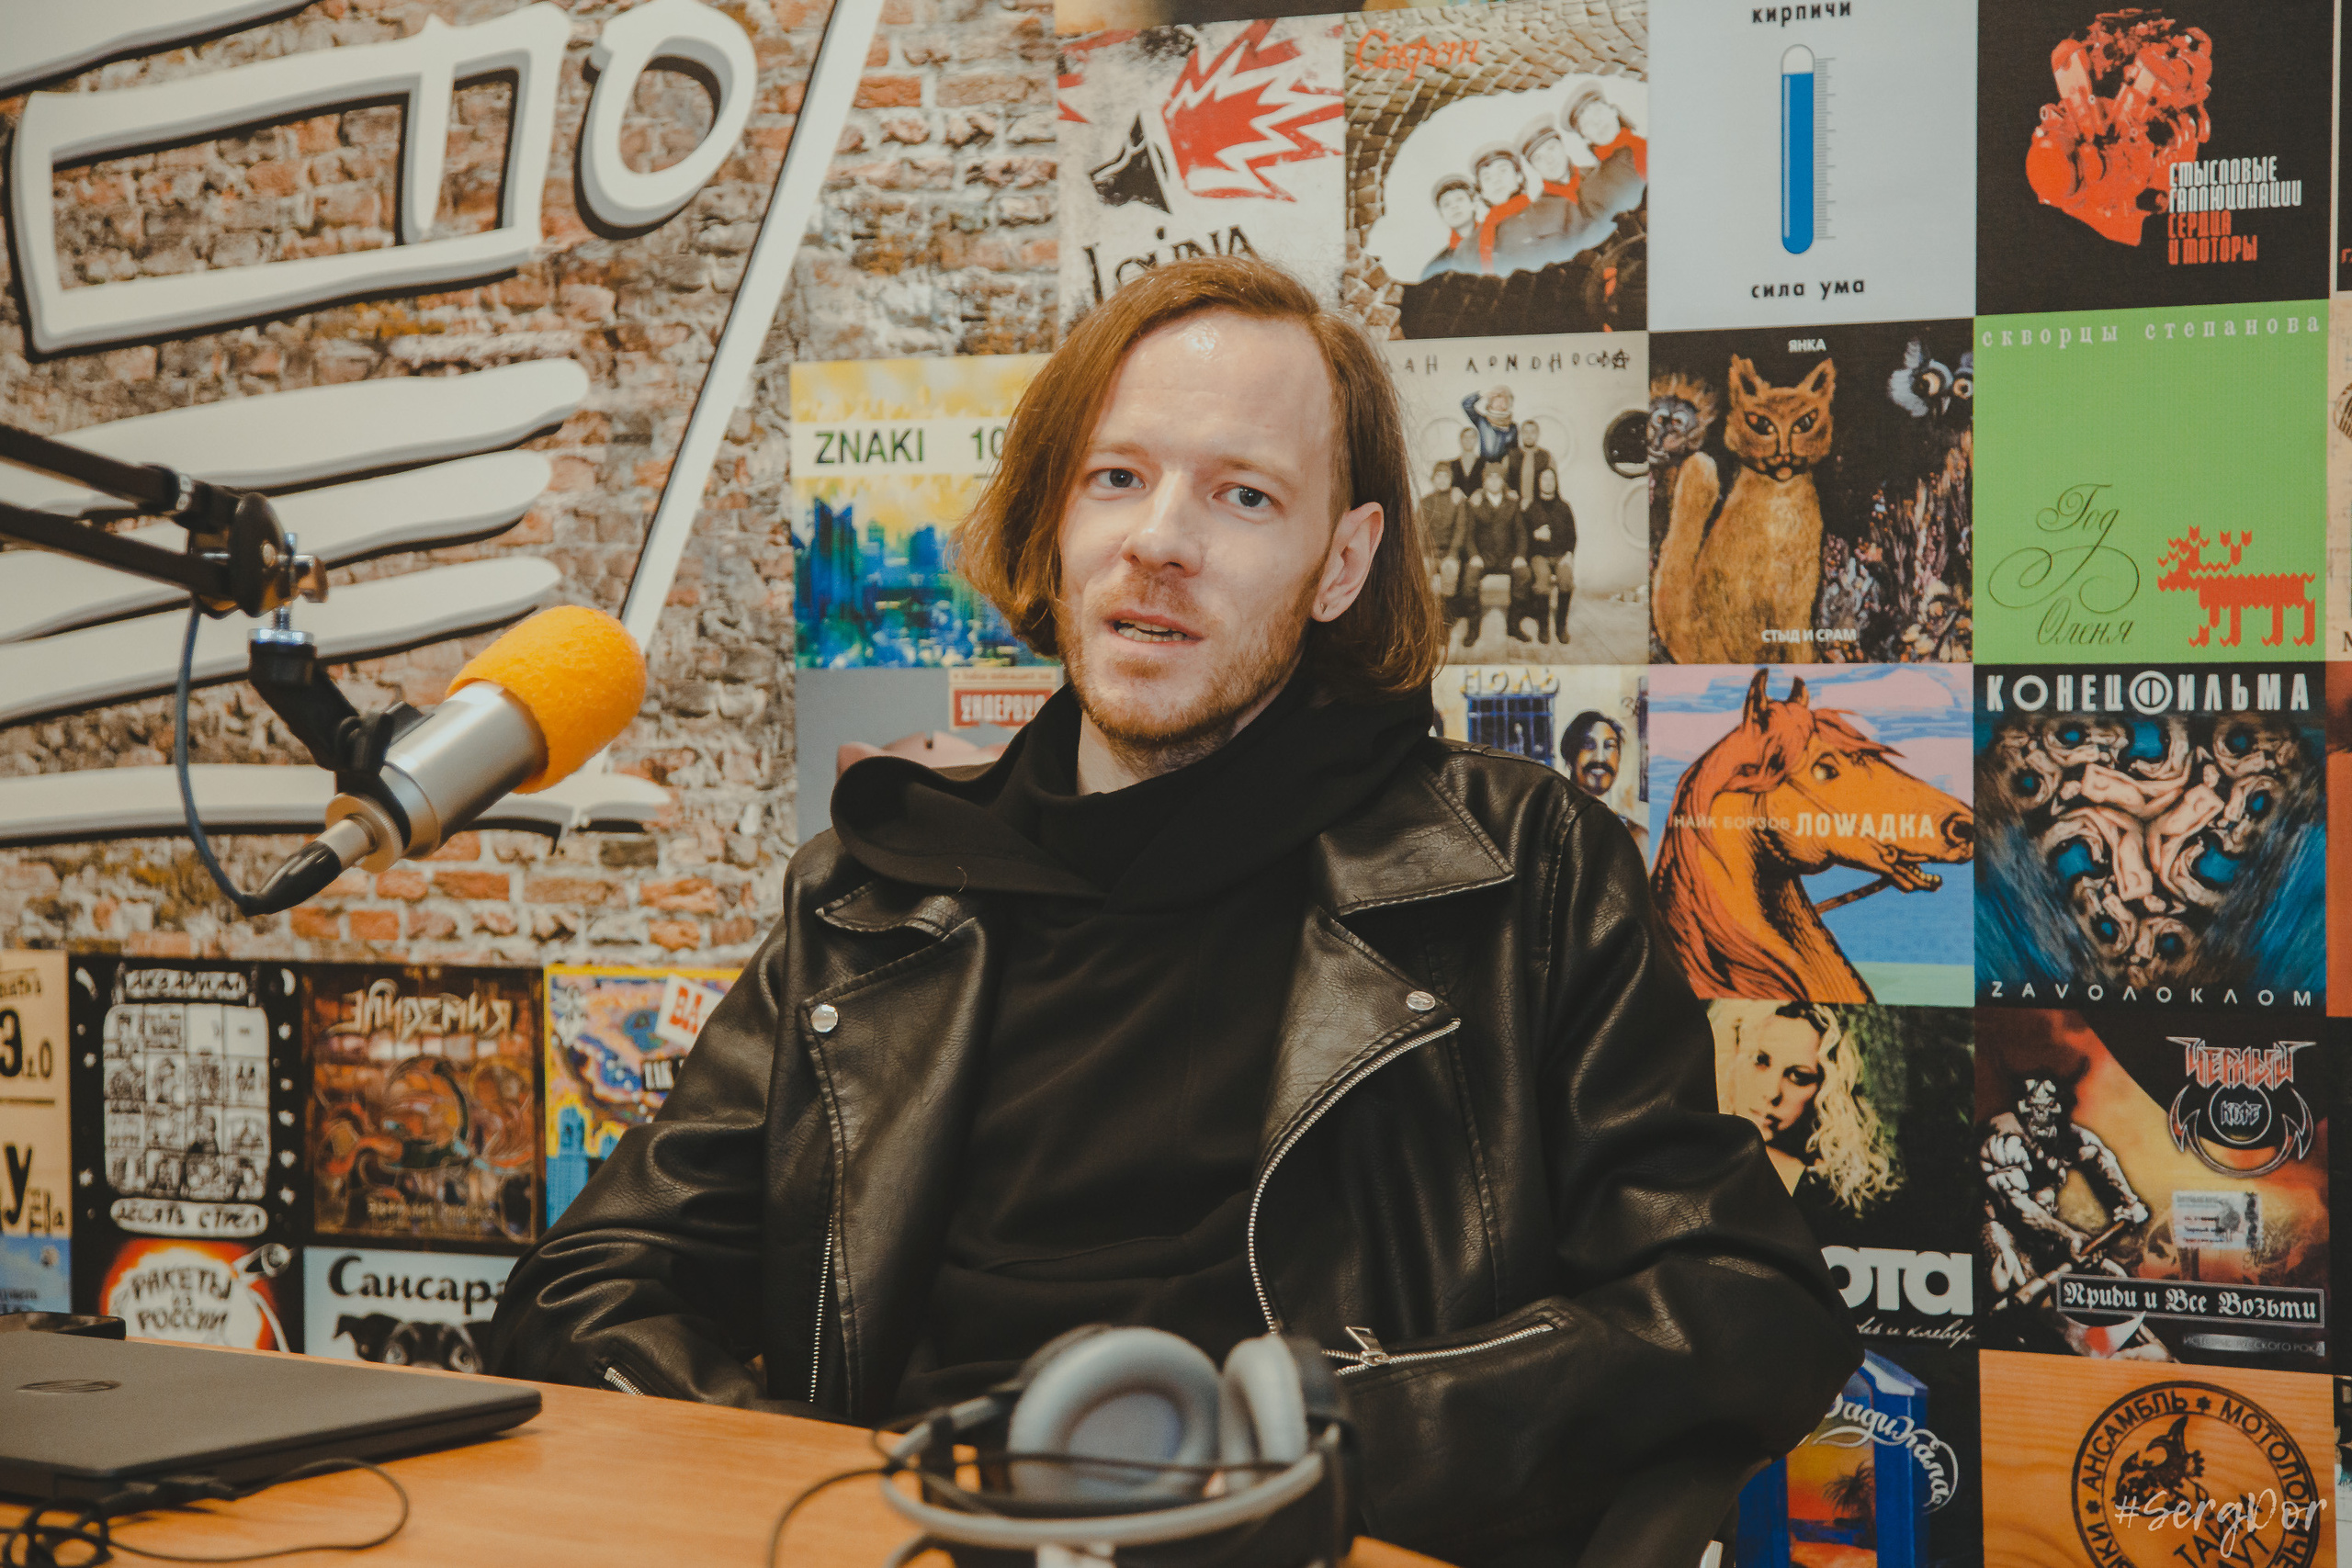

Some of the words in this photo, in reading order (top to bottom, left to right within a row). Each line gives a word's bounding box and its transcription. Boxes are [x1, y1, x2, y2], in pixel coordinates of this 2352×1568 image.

[1752, 2, 1851, 27] кирпичи
[2169, 155, 2278, 188] СМЫСЛОВЫЕ
[2168, 179, 2302, 214] ГАЛЛЮЦИНАЦИИ
[2167, 209, 2232, 239] СЕРДЦА
[2168, 238, 2179, 265] И
[2182, 234, 2258, 265] МОТОРЫ
[1751, 283, 1804, 299] сила
[1820, 279, 1865, 300] ума
[1788, 338, 1827, 353] ЯНКА
[1982, 324, 2119, 349] скворцы
[2145, 316, 2320, 339] степанова
[815, 427, 923, 464] ZNAKI
[1761, 629, 1801, 643] СТЫД
[1802, 630, 1814, 642] И
[1815, 628, 1857, 642] СРАМ
[1673, 813, 1716, 829] НАЙК
[1723, 816, 1791, 830] БОРЗОВ
[131, 1267, 232, 1301] РАКЕТЫ
[2143, 1291, 2158, 1309] и
[2165, 1288, 2208, 1313] Все
[2081, 1389, 2188, 1493] АНСАМБЛЬ
